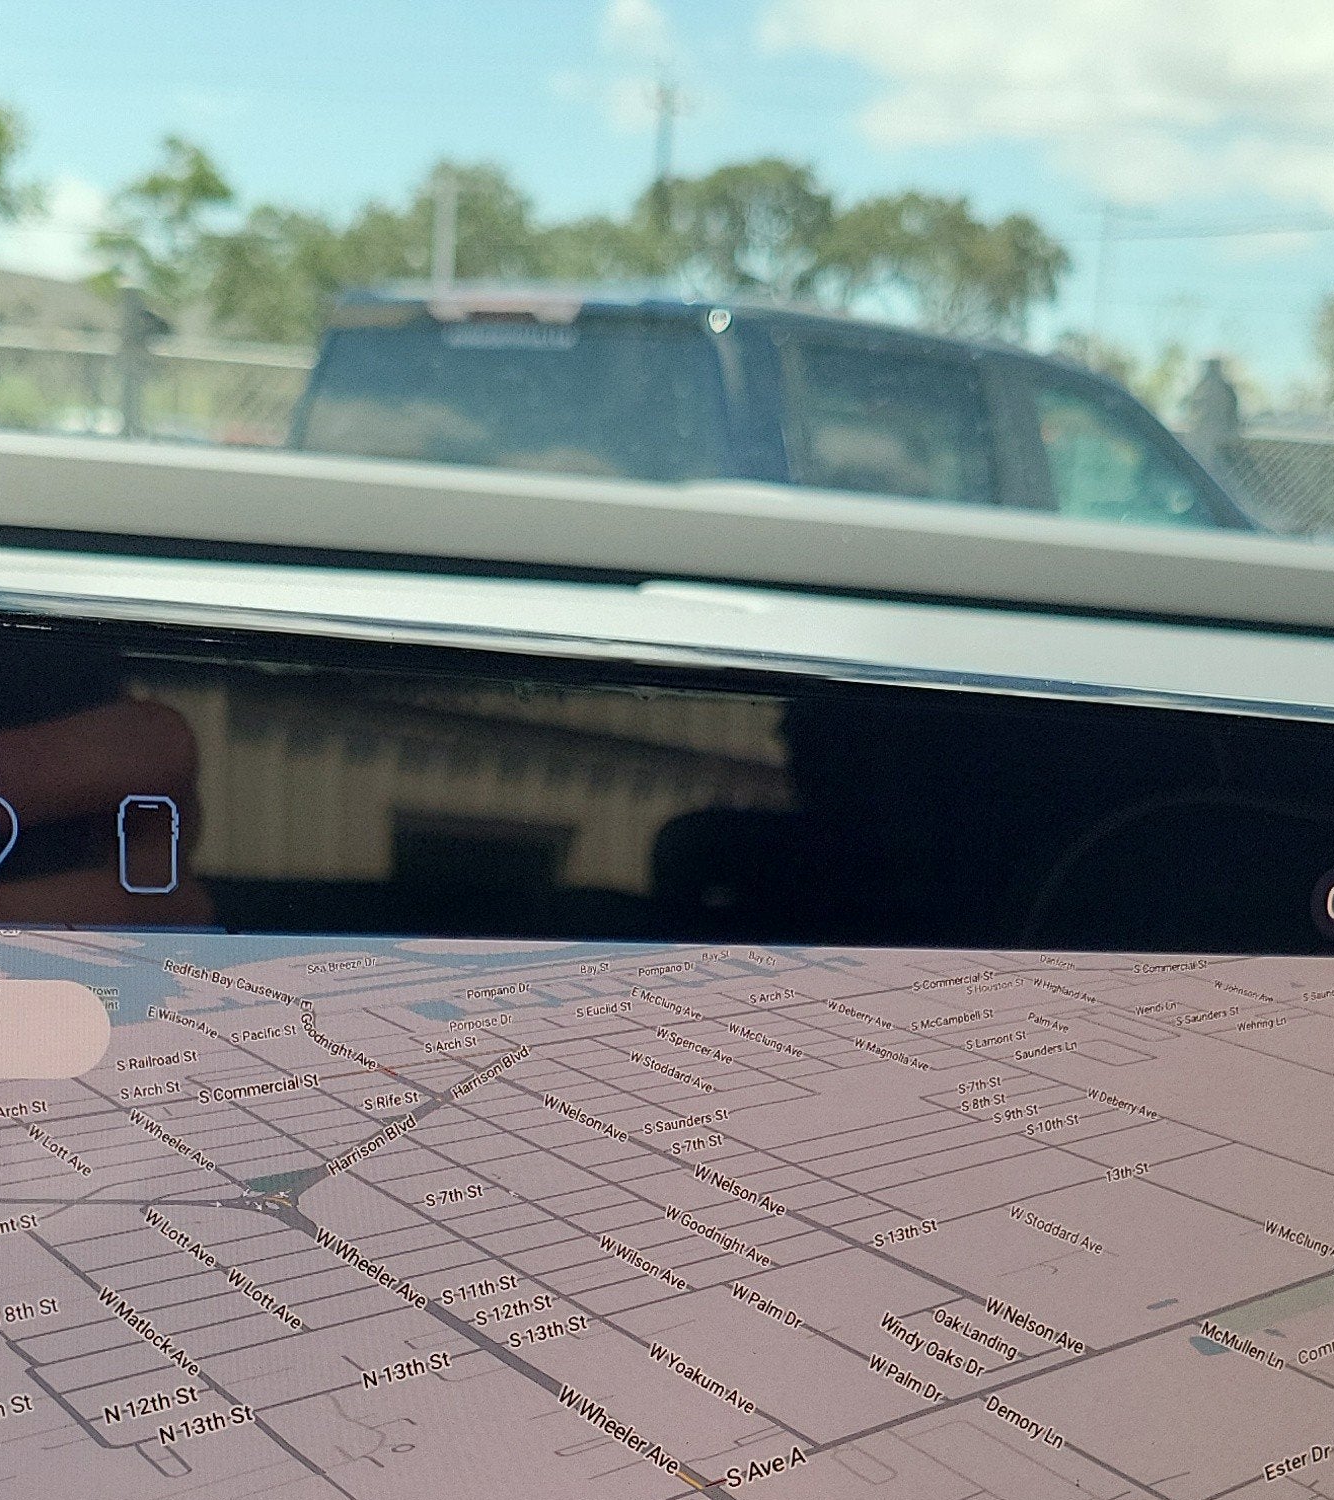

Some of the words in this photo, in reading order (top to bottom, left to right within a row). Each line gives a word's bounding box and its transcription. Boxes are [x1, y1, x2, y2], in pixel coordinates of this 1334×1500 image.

[165, 959, 207, 981] Redfish
[211, 972, 233, 988] Bay
[237, 977, 295, 1006] Causeway
[199, 1090, 209, 1103] S
[213, 1078, 300, 1102] Commercial
[303, 1074, 319, 1088] St
[453, 1064, 501, 1098] Harrison
[501, 1046, 529, 1070] Blvd
[543, 1094, 559, 1110] W
[559, 1101, 603, 1130] Nelson
[603, 1121, 627, 1142] Ave
[643, 1122, 653, 1134] S
[656, 1113, 711, 1132] Saunders
[713, 1110, 729, 1122] St
[1087, 1088, 1098, 1100] W
[1100, 1092, 1137, 1115] Deberry
[1139, 1105, 1157, 1119] Ave
[29, 1126, 44, 1142] W
[43, 1133, 68, 1157] Lott
[65, 1153, 91, 1176] Ave
[328, 1136, 385, 1176] Harrison
[385, 1115, 417, 1142] Blvd
[18, 1214, 38, 1230] St
[145, 1208, 165, 1228] W
[160, 1218, 188, 1249] Lott
[187, 1242, 215, 1268] Ave
[1010, 1206, 1023, 1220] W
[1025, 1212, 1079, 1244] Stoddard
[1079, 1236, 1103, 1254] Ave
[315, 1229, 336, 1250] W
[335, 1239, 395, 1290] Wheeler
[397, 1283, 426, 1309] Ave
[442, 1291, 453, 1304] S
[459, 1280, 495, 1301] 11th
[498, 1275, 517, 1291] St
[5, 1303, 34, 1324] 8th
[39, 1299, 58, 1314] St
[98, 1287, 118, 1307] W
[115, 1300, 173, 1354] Matlock
[171, 1352, 199, 1376] Ave
[509, 1334, 521, 1347] S
[526, 1322, 563, 1343] 13th
[567, 1316, 587, 1332] St
[934, 1309, 962, 1332] Oak
[963, 1322, 1017, 1361] Landing
[986, 1297, 1003, 1314] W
[1003, 1306, 1055, 1341] Nelson
[1057, 1332, 1084, 1353] Ave
[881, 1312, 925, 1352] Windy
[927, 1342, 963, 1369] Oaks
[964, 1359, 985, 1377] Dr
[1201, 1321, 1265, 1363] McMullen
[1266, 1352, 1284, 1370] Ln
[649, 1342, 667, 1361] W
[667, 1353, 727, 1398] Yoakum
[727, 1391, 755, 1414] Ave
[869, 1354, 887, 1372] W
[885, 1364, 921, 1394] Palm
[923, 1385, 943, 1402] Dr
[11, 1396, 33, 1414] St
[159, 1426, 176, 1444] N
[180, 1416, 225, 1440] 13th
[229, 1406, 255, 1426] St
[986, 1396, 1044, 1439] Demory
[1044, 1430, 1064, 1448] Ln
[558, 1385, 581, 1409] W
[580, 1398, 648, 1453] Wheeler
[647, 1446, 678, 1474] Ave
[726, 1468, 742, 1487] S
[746, 1455, 786, 1482] Ave
[788, 1447, 806, 1466] A
[1264, 1452, 1307, 1481] Ester
[1311, 1445, 1331, 1463] Dr
